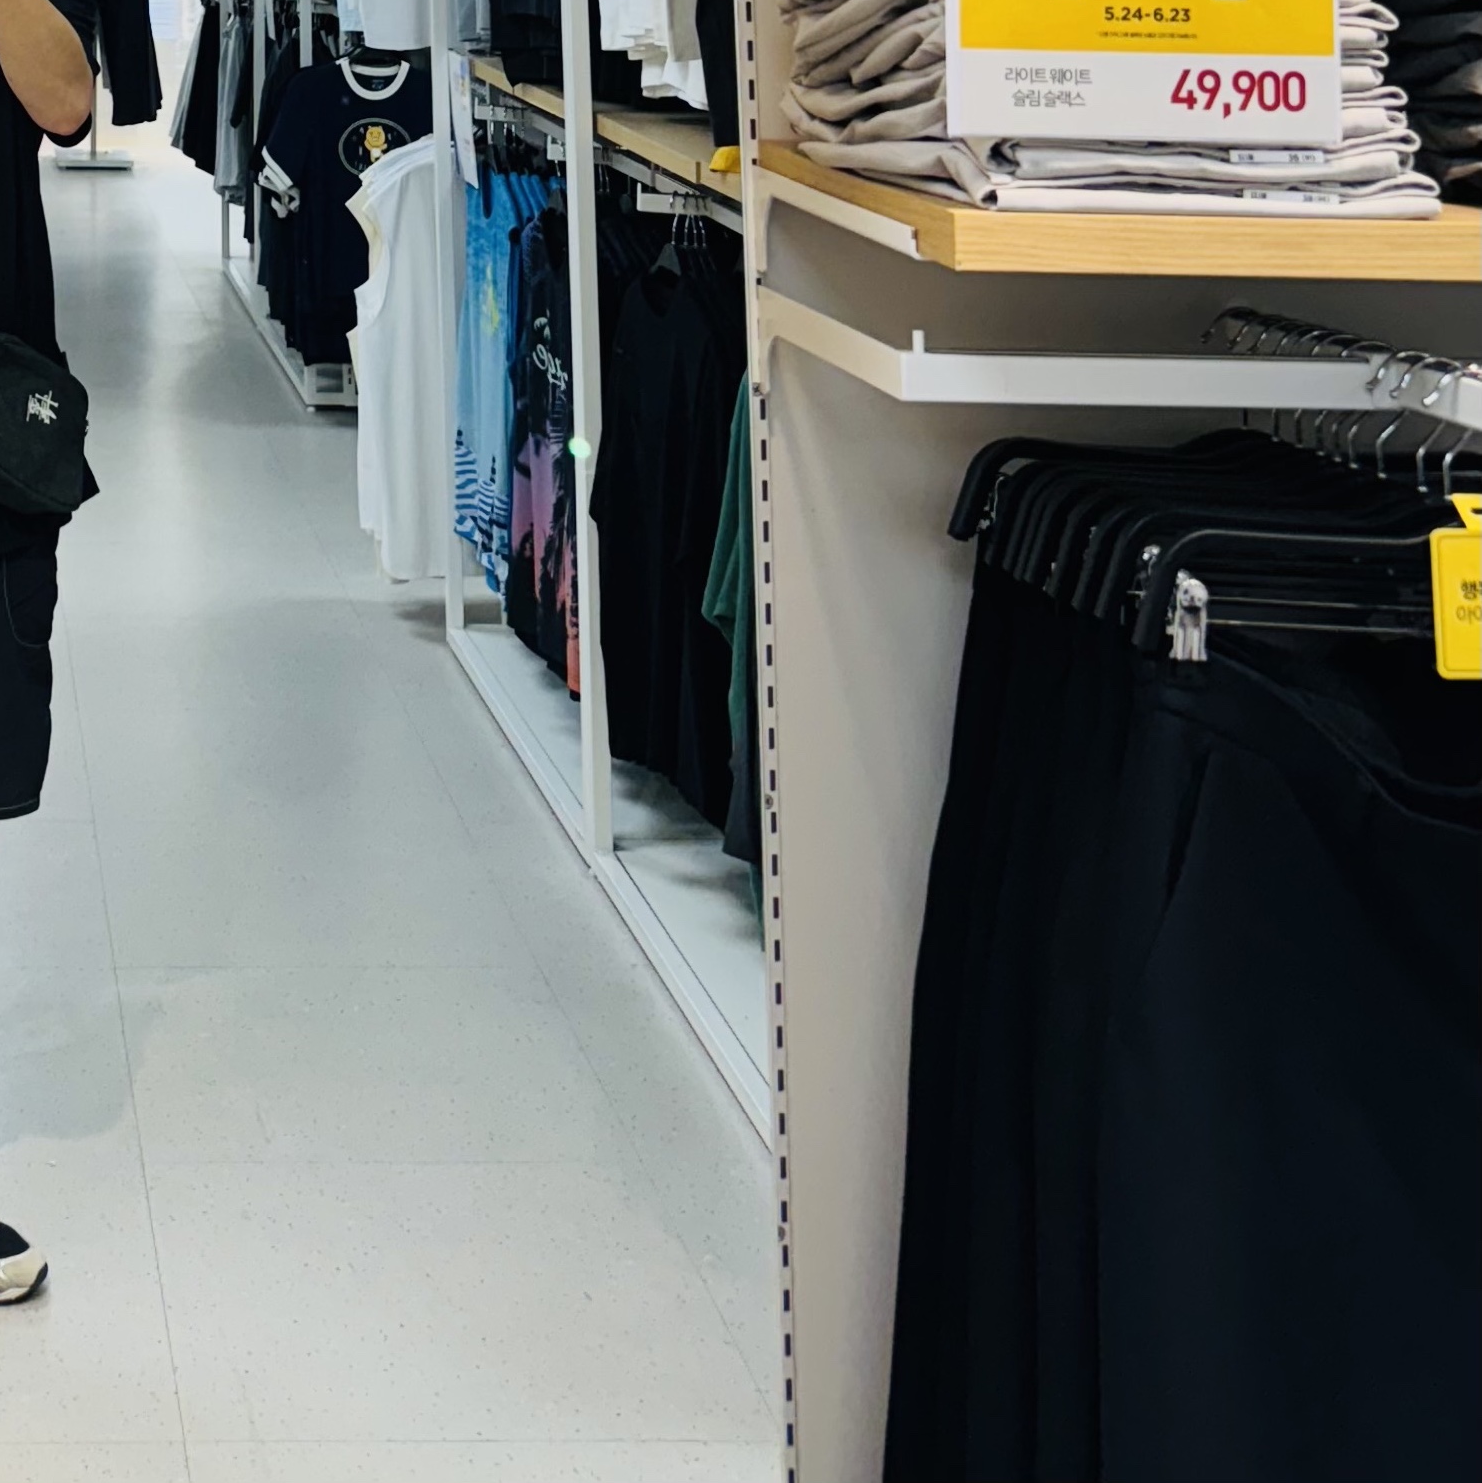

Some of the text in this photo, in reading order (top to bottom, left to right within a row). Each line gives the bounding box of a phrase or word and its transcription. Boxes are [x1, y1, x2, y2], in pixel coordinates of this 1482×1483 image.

[1104, 6, 1191, 23] 5.24-6.23
[1170, 69, 1306, 119] 49,900
[1460, 579, 1481, 600] 행
